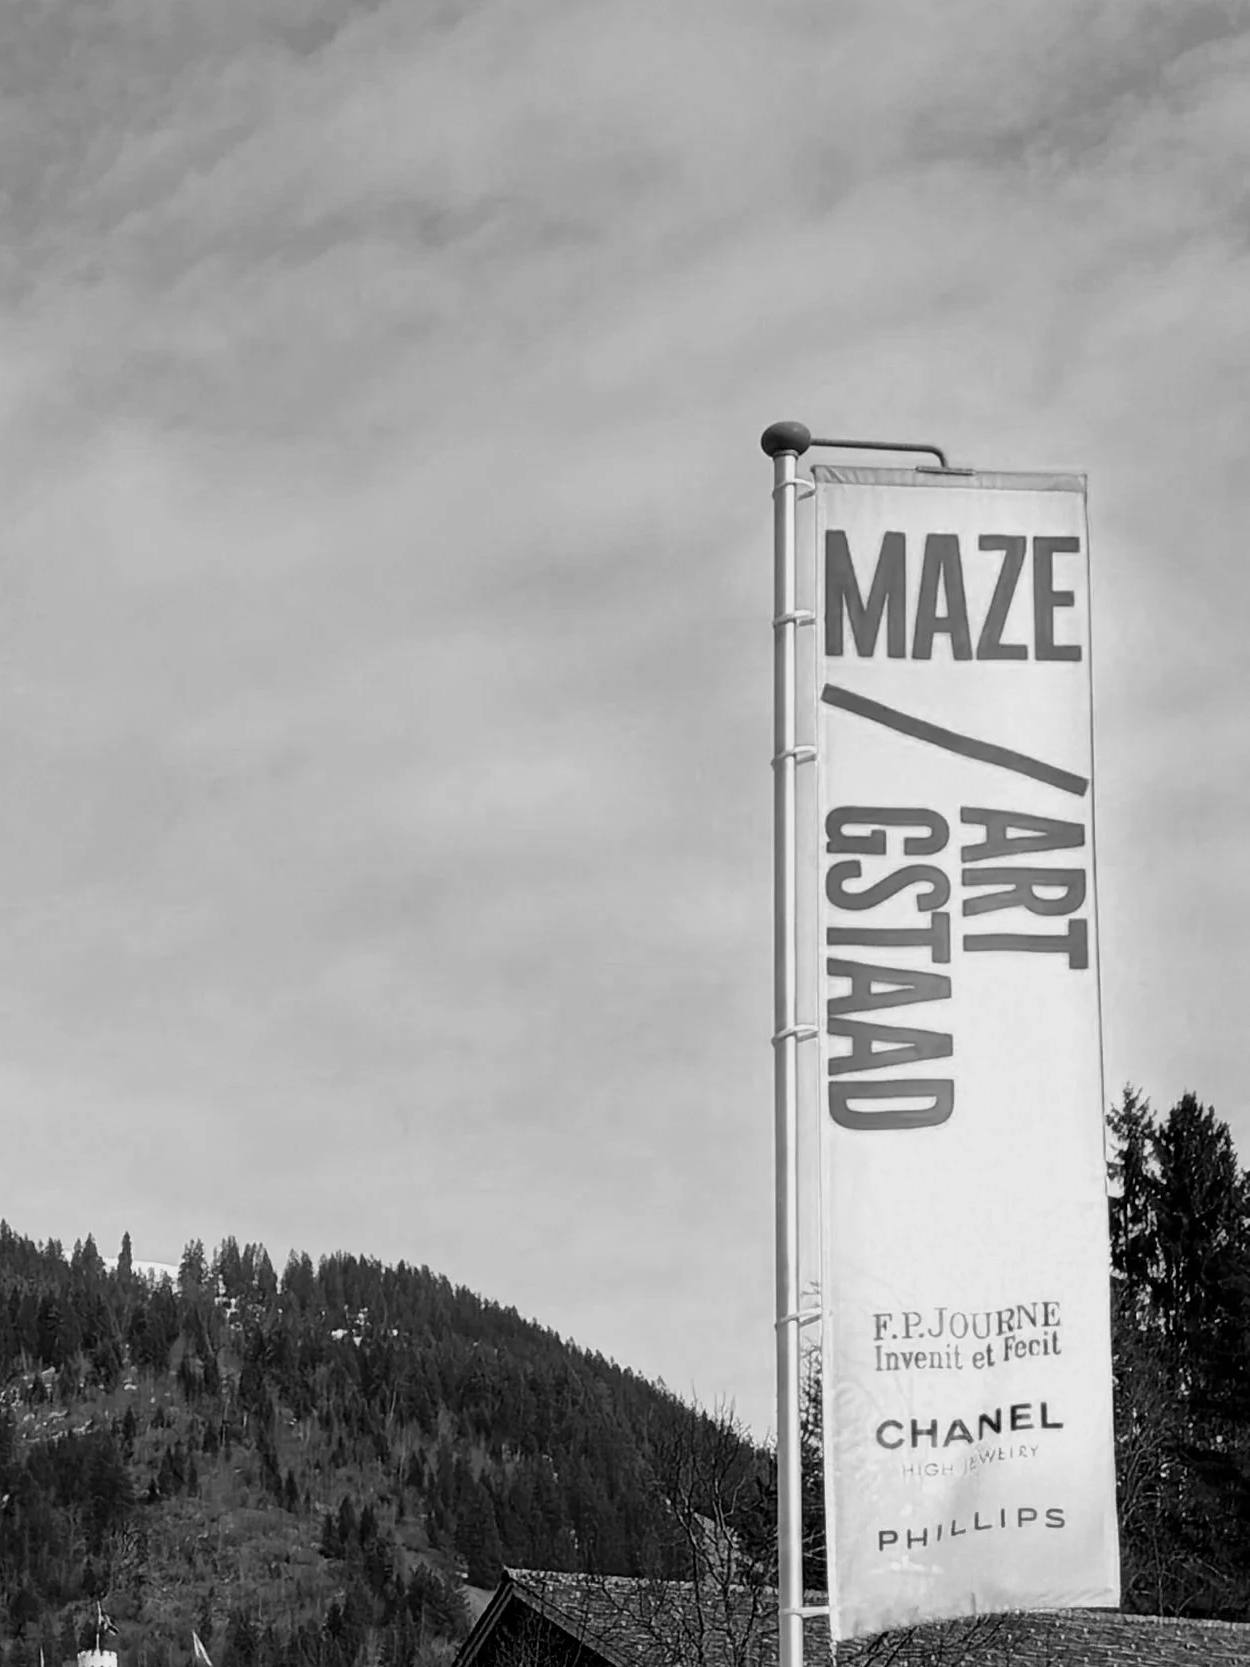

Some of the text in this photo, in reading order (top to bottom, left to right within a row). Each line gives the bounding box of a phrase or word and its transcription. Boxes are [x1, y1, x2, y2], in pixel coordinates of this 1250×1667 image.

[824, 529, 1082, 661] MAZE
[960, 806, 1089, 969] ART
[825, 806, 955, 1130] GSTAAD
[875, 1331, 1062, 1371] Invenit et Fecit
[876, 1402, 1063, 1449] CHANEL
[902, 1463, 953, 1478] HIGH
[878, 1508, 1066, 1551] PHILLIPS
